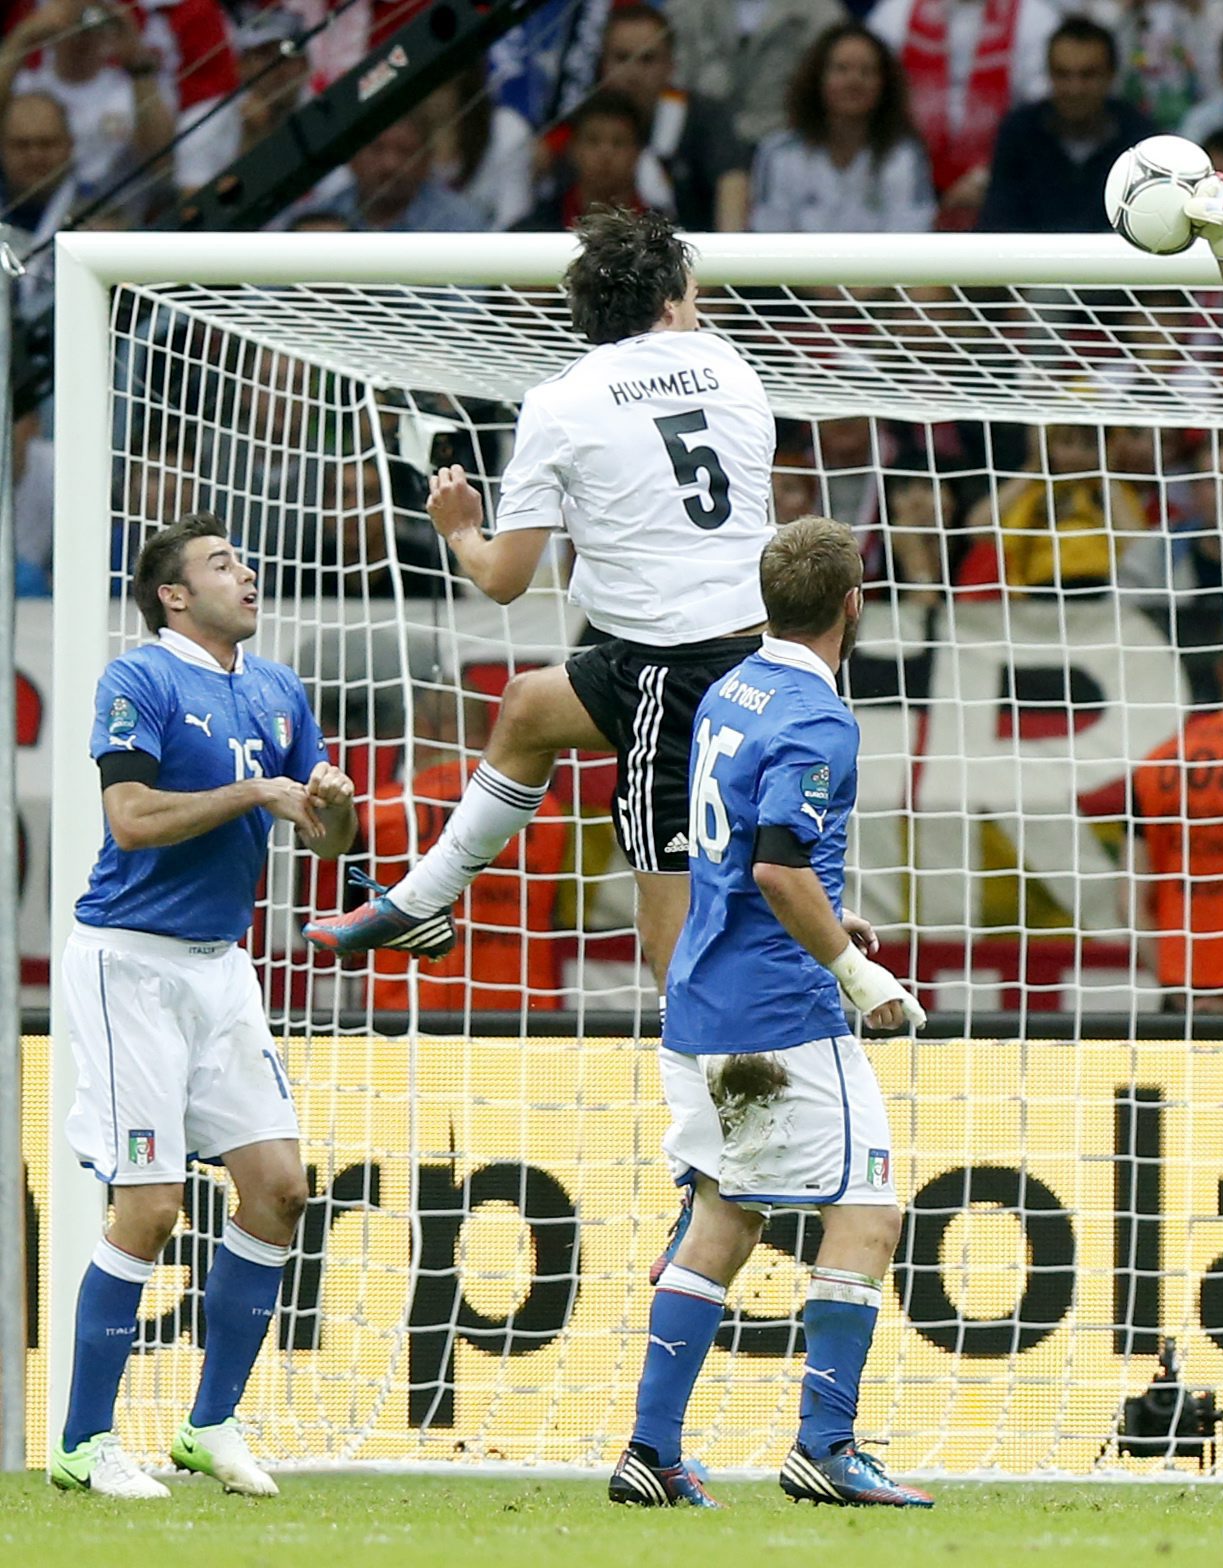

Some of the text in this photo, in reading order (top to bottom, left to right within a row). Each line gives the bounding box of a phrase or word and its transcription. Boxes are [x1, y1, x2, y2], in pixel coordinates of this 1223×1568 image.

[609, 368, 719, 405] HUMMELS
[653, 408, 732, 530] 5
[688, 717, 745, 864] 16
[261, 1049, 295, 1100] 1
